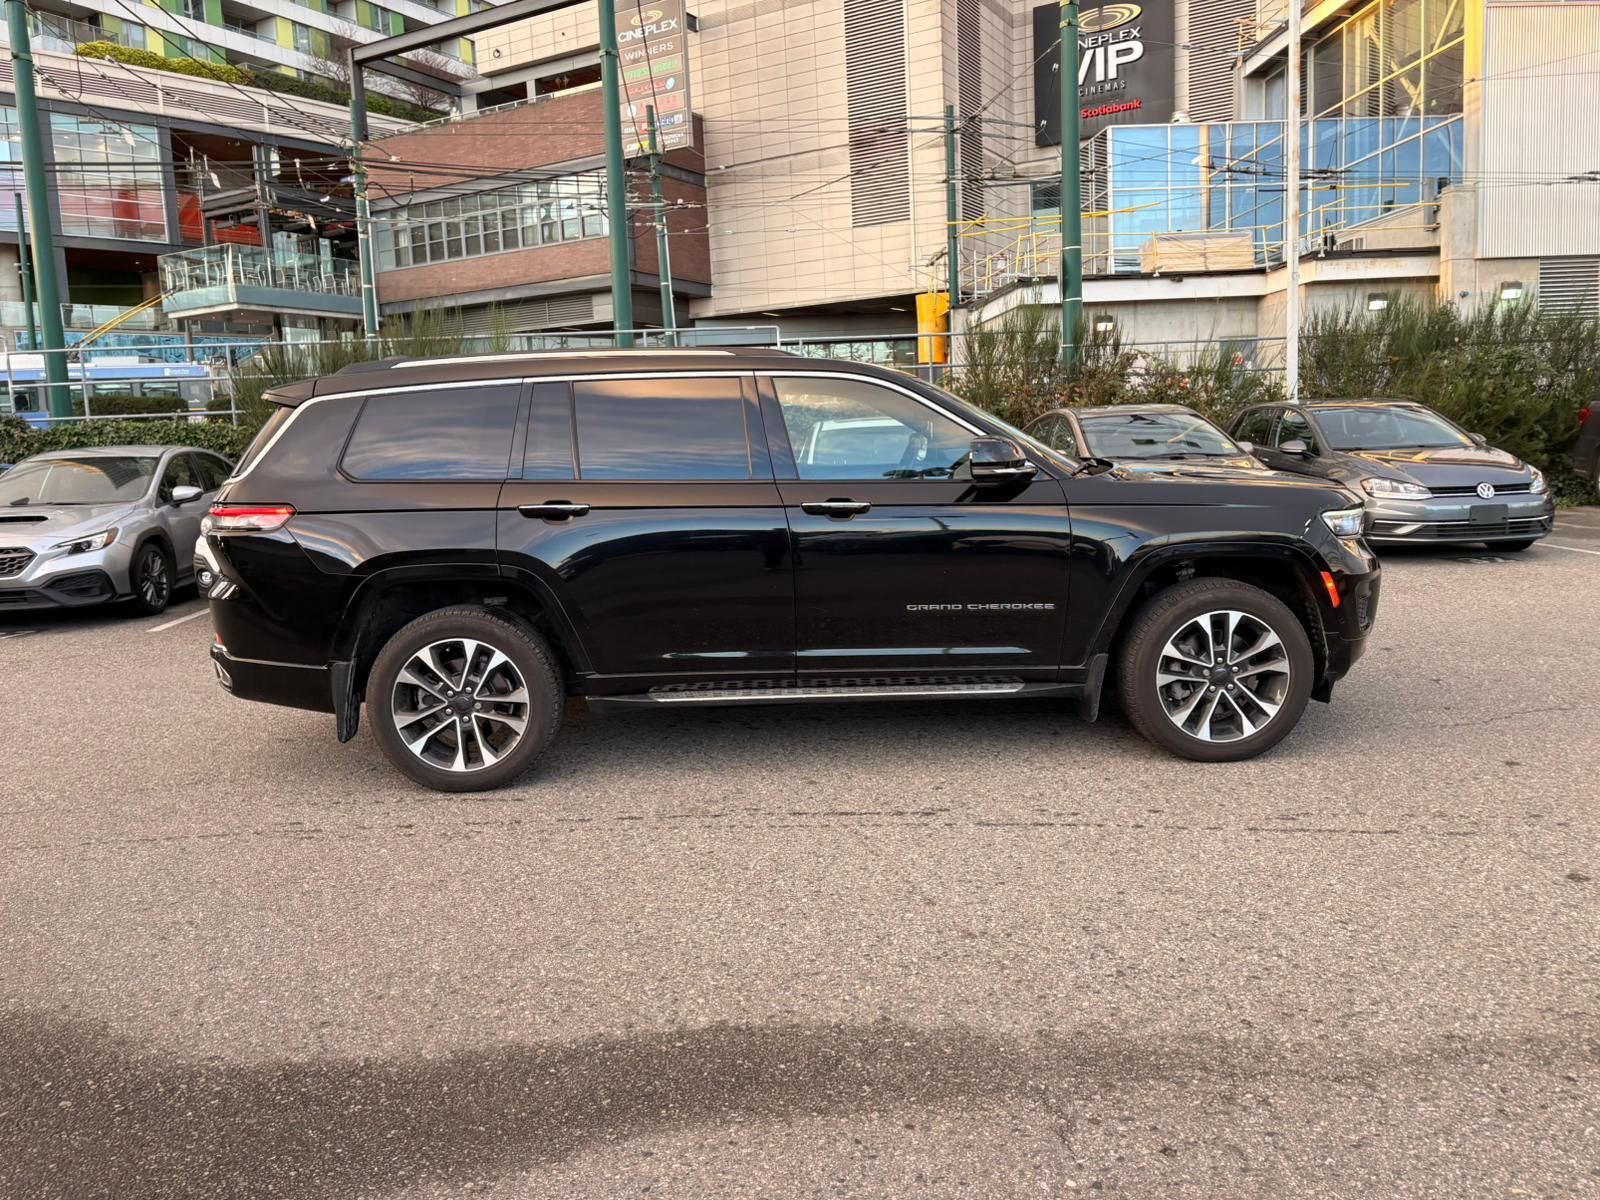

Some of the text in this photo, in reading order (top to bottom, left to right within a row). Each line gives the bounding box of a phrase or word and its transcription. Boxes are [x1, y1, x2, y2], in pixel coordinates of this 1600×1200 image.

[618, 18, 678, 42] CINEPLEX
[1078, 26, 1141, 49] NEPLEX
[624, 42, 674, 61] WINNERS
[1078, 80, 1126, 97] CINEMAS
[1081, 99, 1142, 119] Scotiabank
